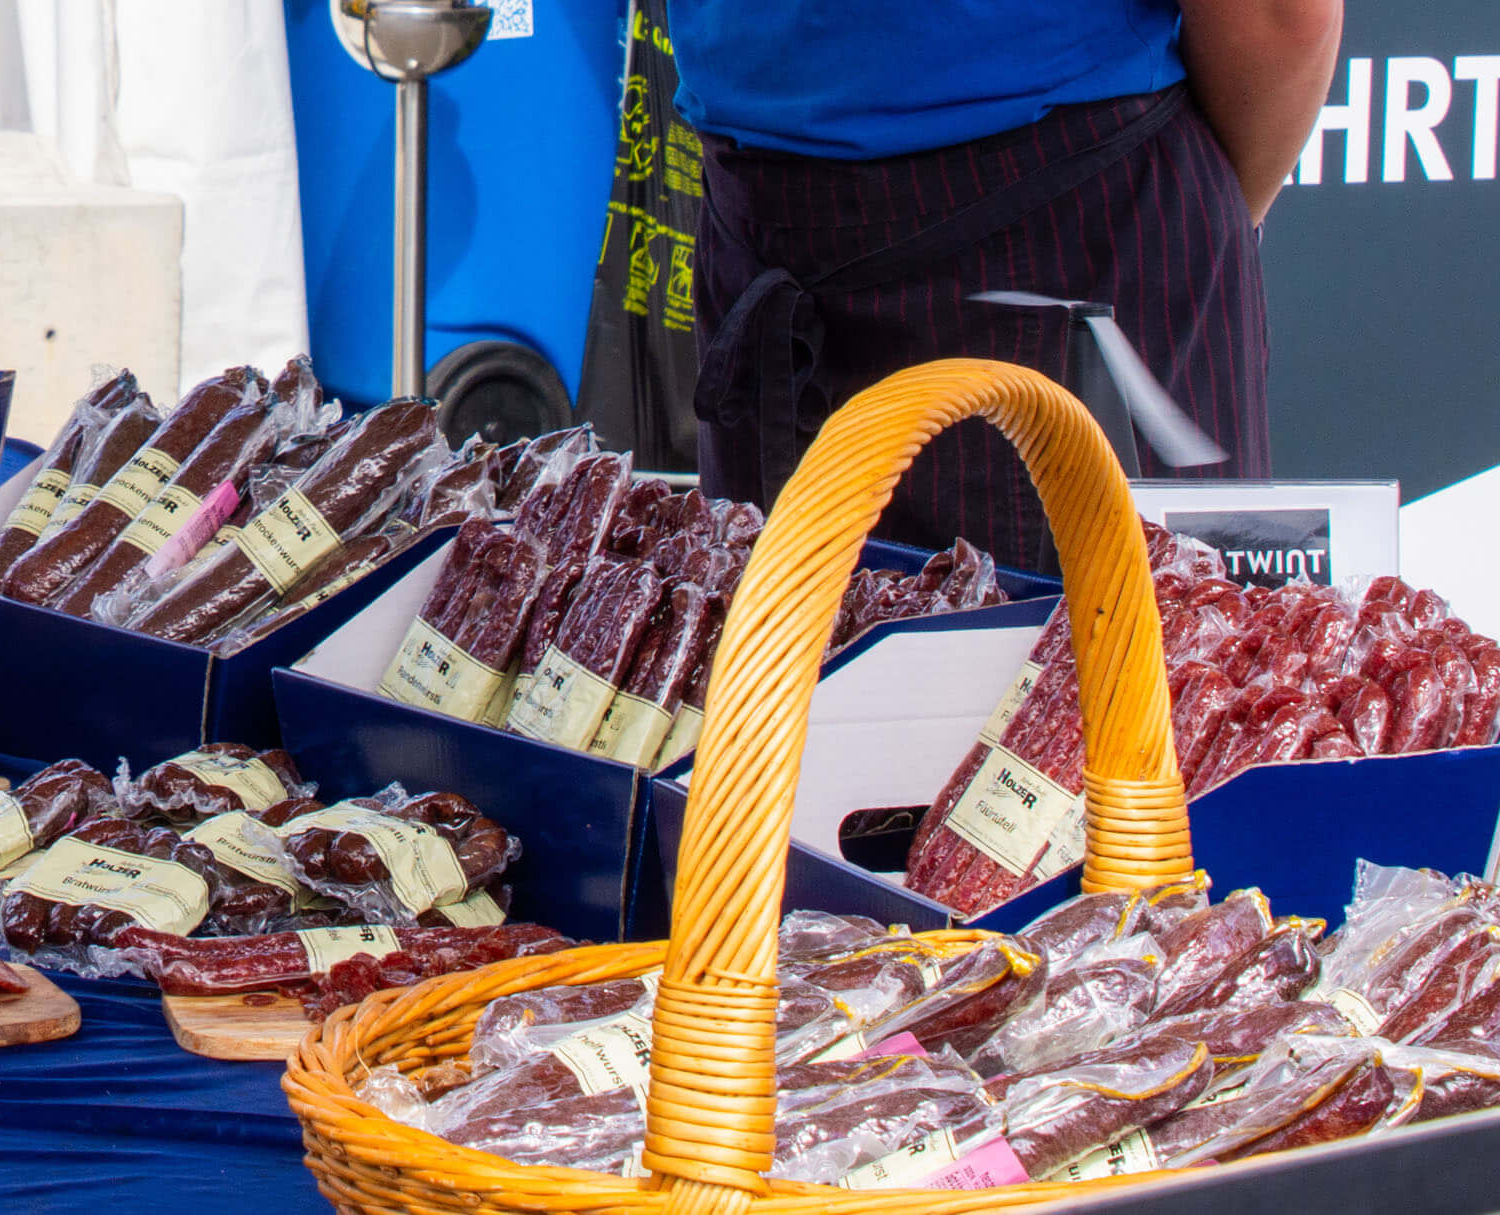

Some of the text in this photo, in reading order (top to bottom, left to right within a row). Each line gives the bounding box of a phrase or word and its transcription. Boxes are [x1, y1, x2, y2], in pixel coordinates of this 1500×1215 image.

[1284, 55, 1500, 186] HRT
[1225, 548, 1326, 575] TWINT
[997, 767, 1038, 810] HOLZER
